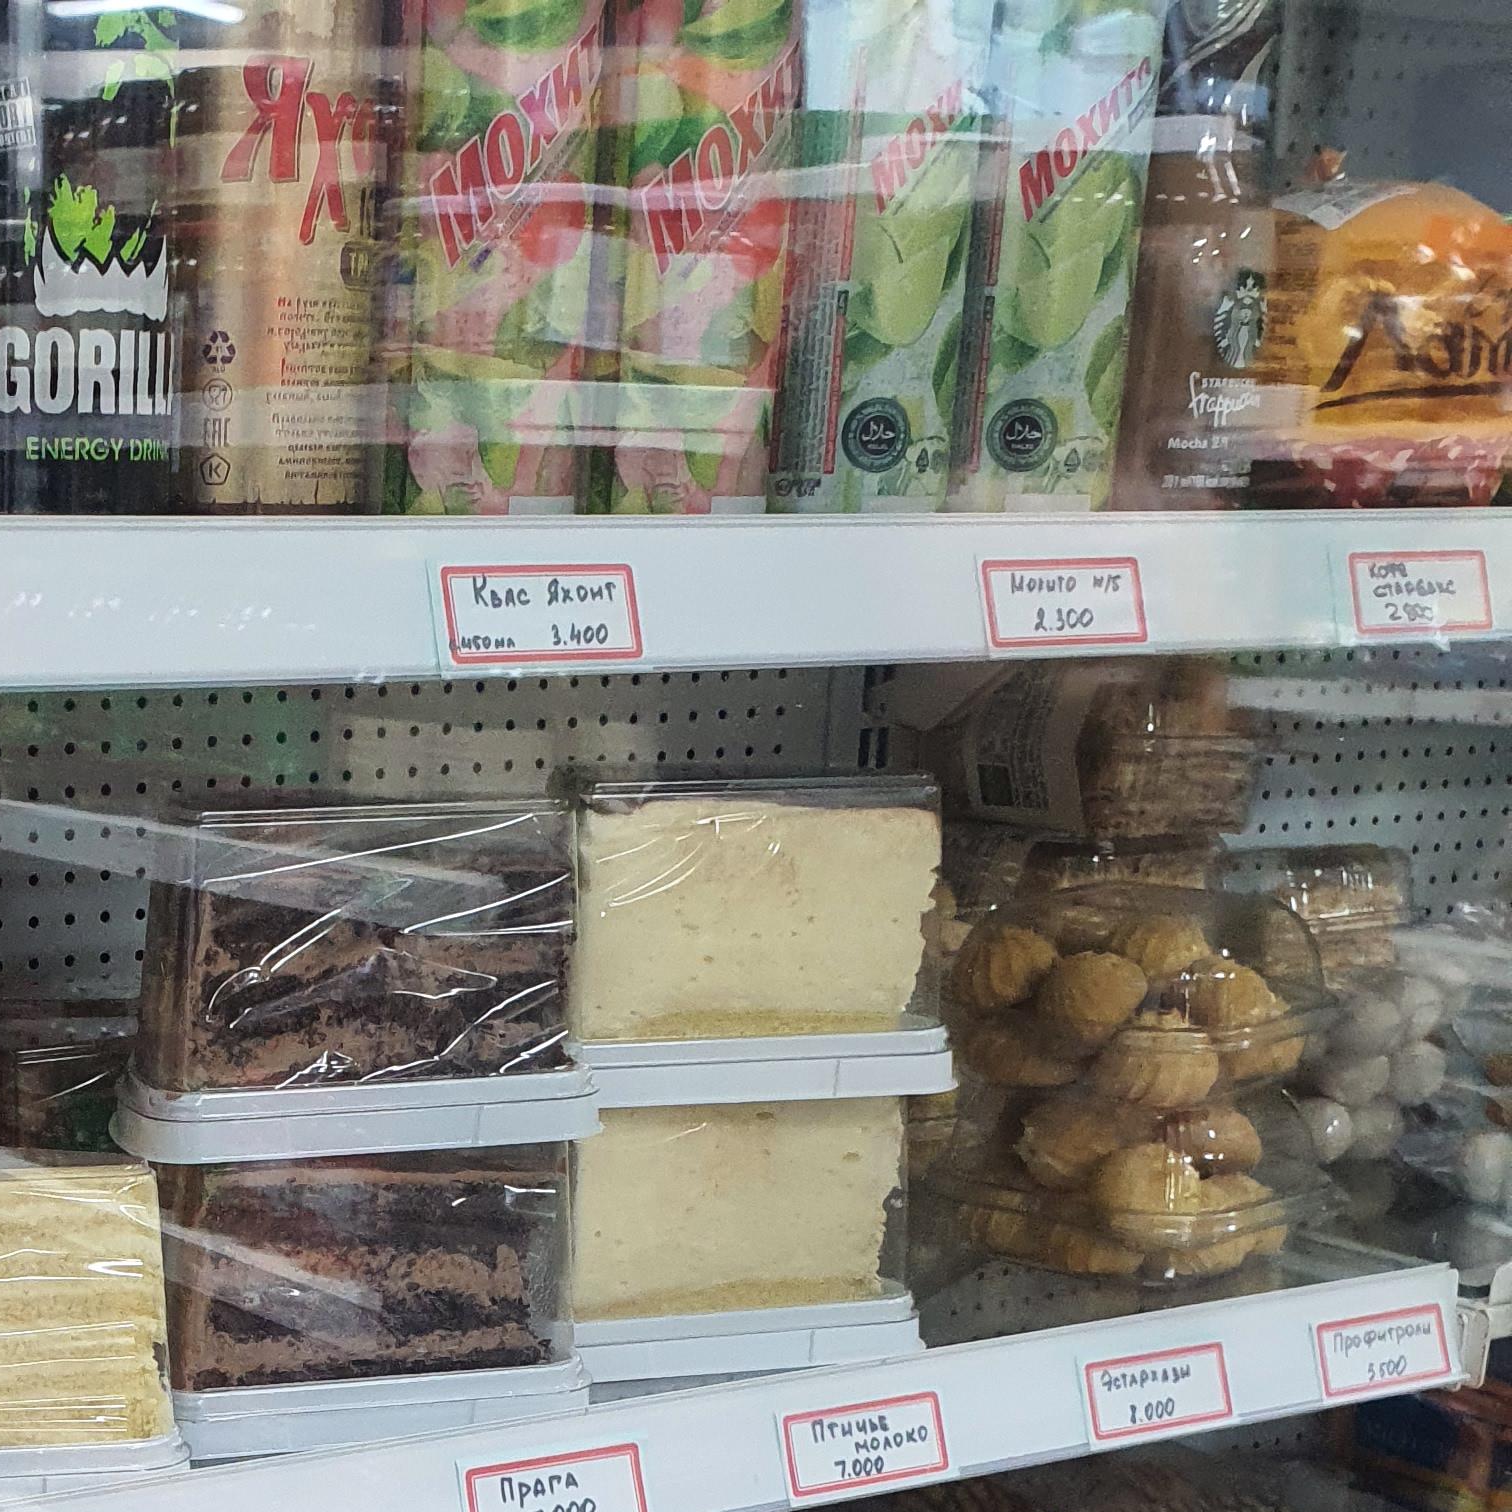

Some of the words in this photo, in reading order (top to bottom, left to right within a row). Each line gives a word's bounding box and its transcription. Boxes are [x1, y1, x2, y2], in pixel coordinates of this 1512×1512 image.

[25, 435, 123, 463] ENERGY
[1034, 607, 1094, 632] 2.300
[834, 1455, 885, 1479] 7.000
